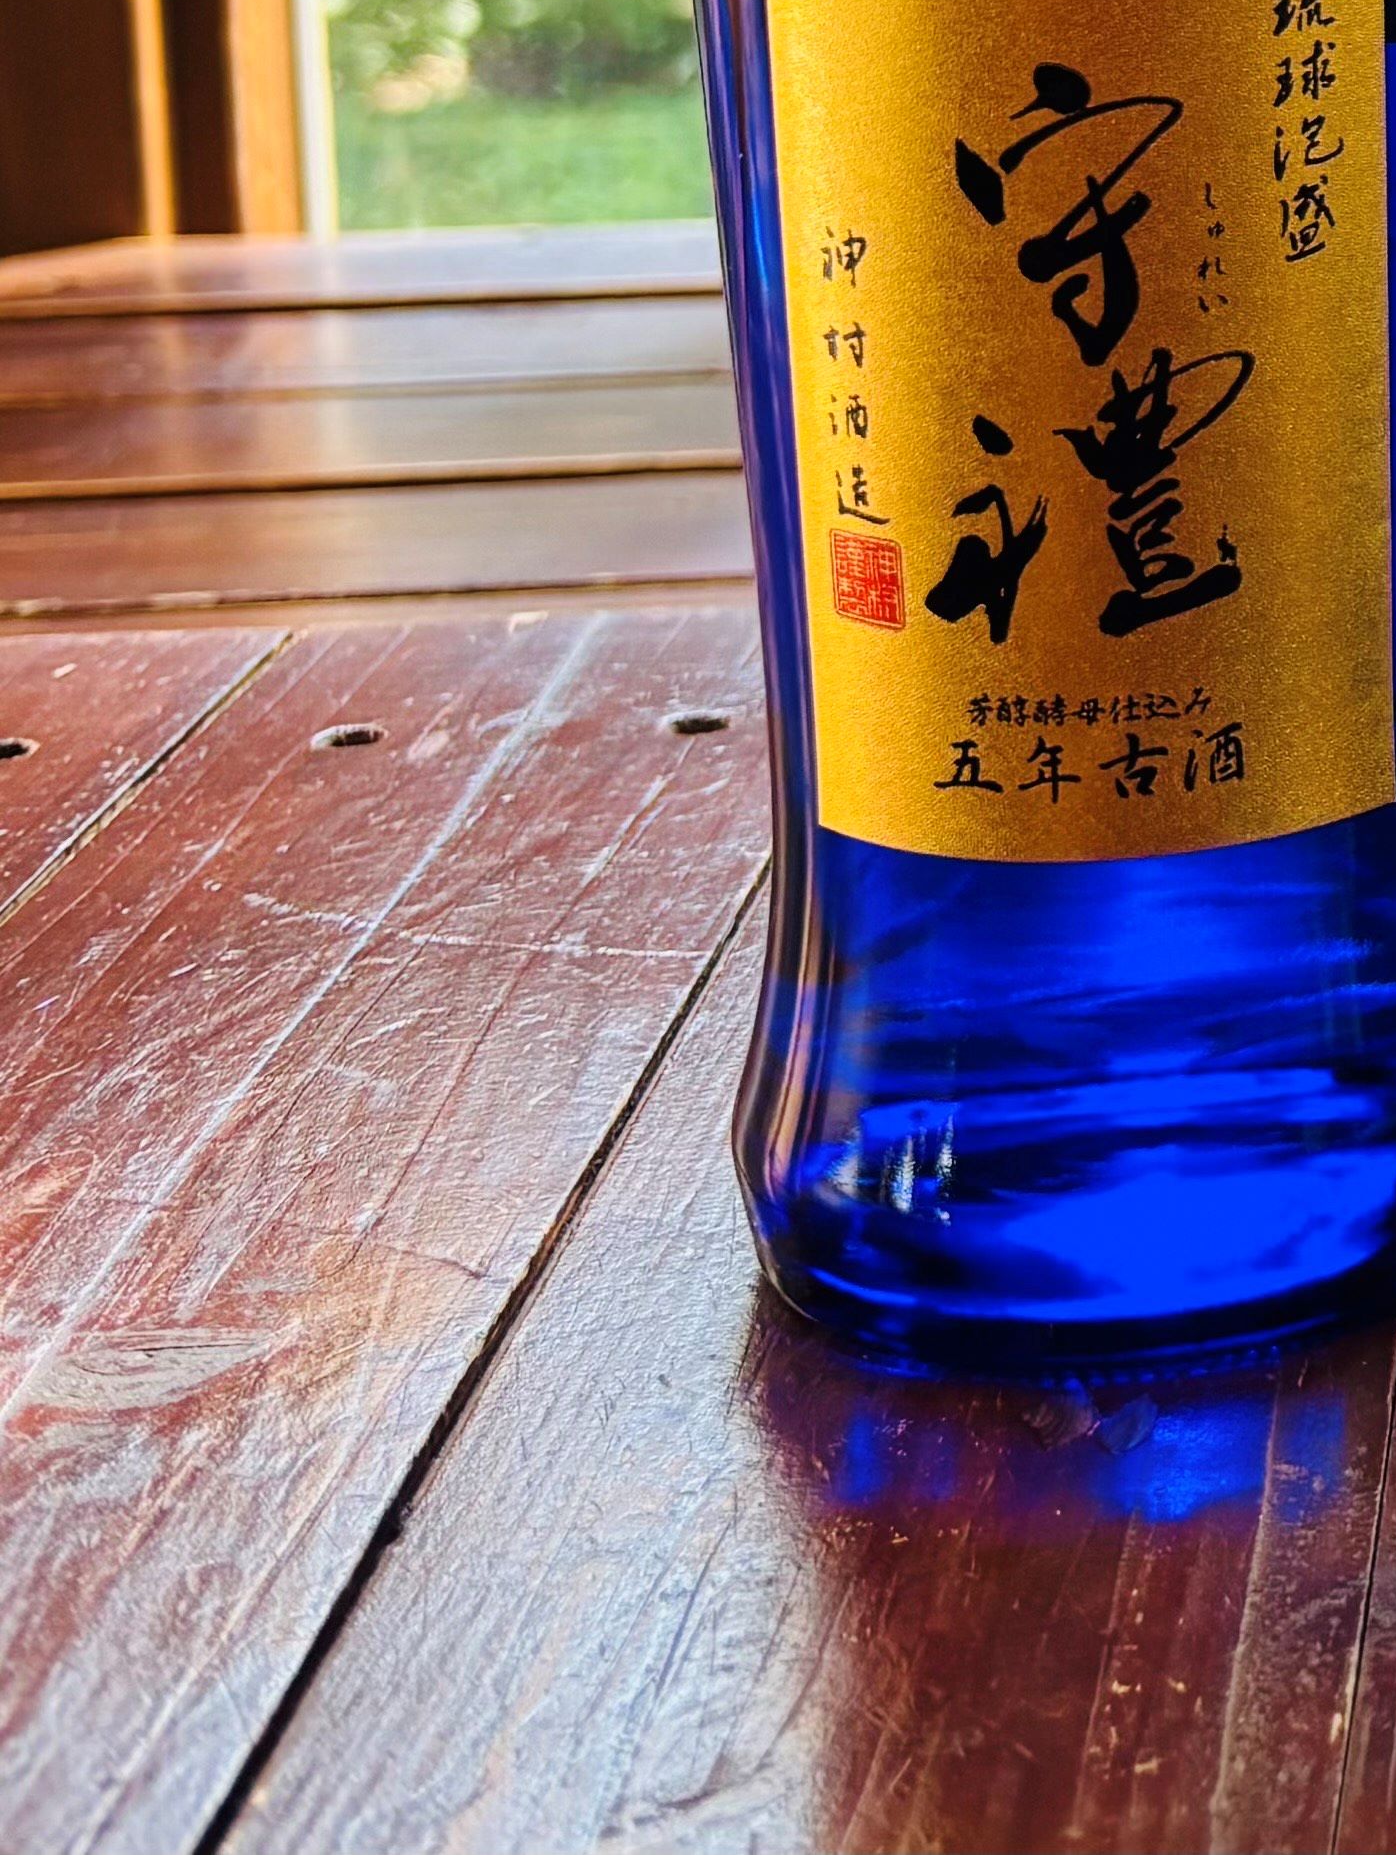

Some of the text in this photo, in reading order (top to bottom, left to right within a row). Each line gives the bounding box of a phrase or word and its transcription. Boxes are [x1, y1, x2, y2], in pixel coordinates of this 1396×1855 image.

[821, 224, 891, 526] 神村酒造
[932, 720, 1246, 805] 五年古酒
